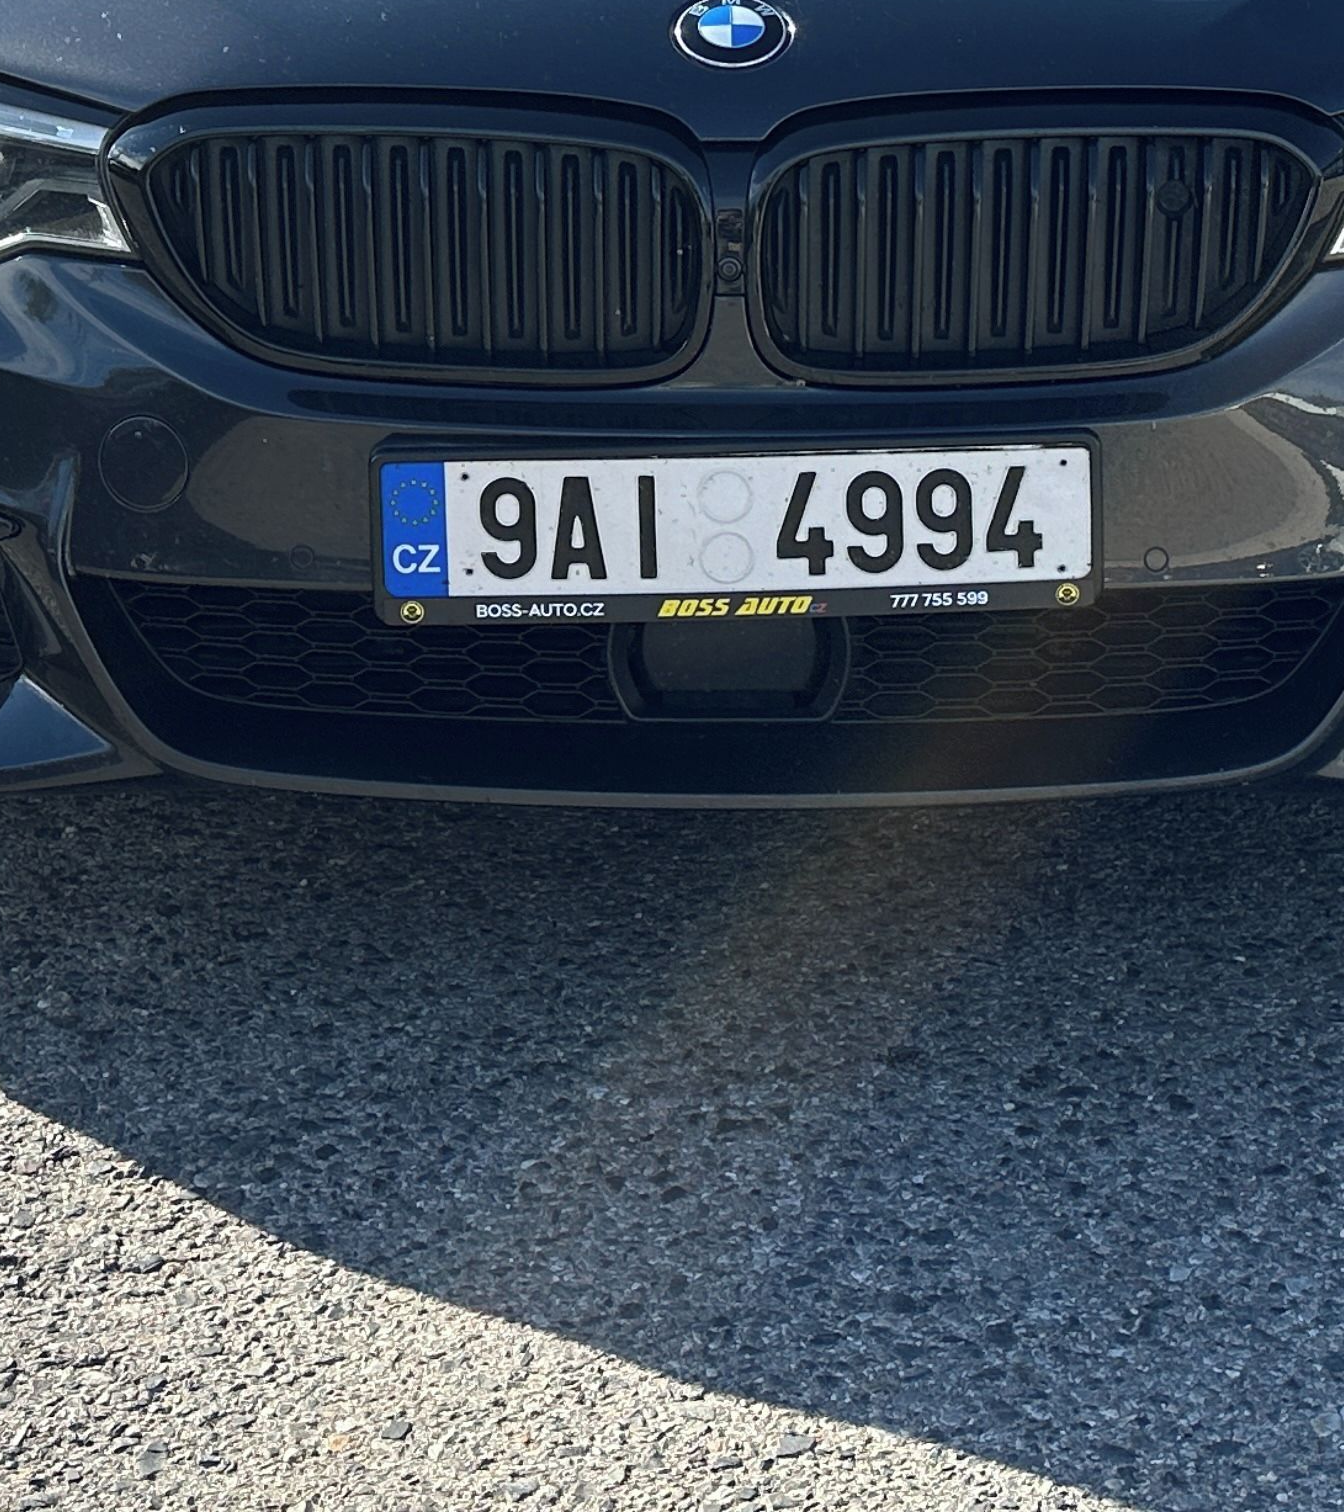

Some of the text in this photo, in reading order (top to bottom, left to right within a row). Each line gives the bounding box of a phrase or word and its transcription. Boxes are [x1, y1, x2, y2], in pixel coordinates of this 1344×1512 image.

[392, 465, 1044, 581] CZ 9AI 4994
[475, 602, 605, 619] BOSS-AUTO.CZ
[657, 598, 731, 618] BOSS
[735, 595, 813, 616] AUTO
[890, 593, 919, 608] 777
[922, 592, 953, 607] 755
[956, 590, 989, 606] 599
